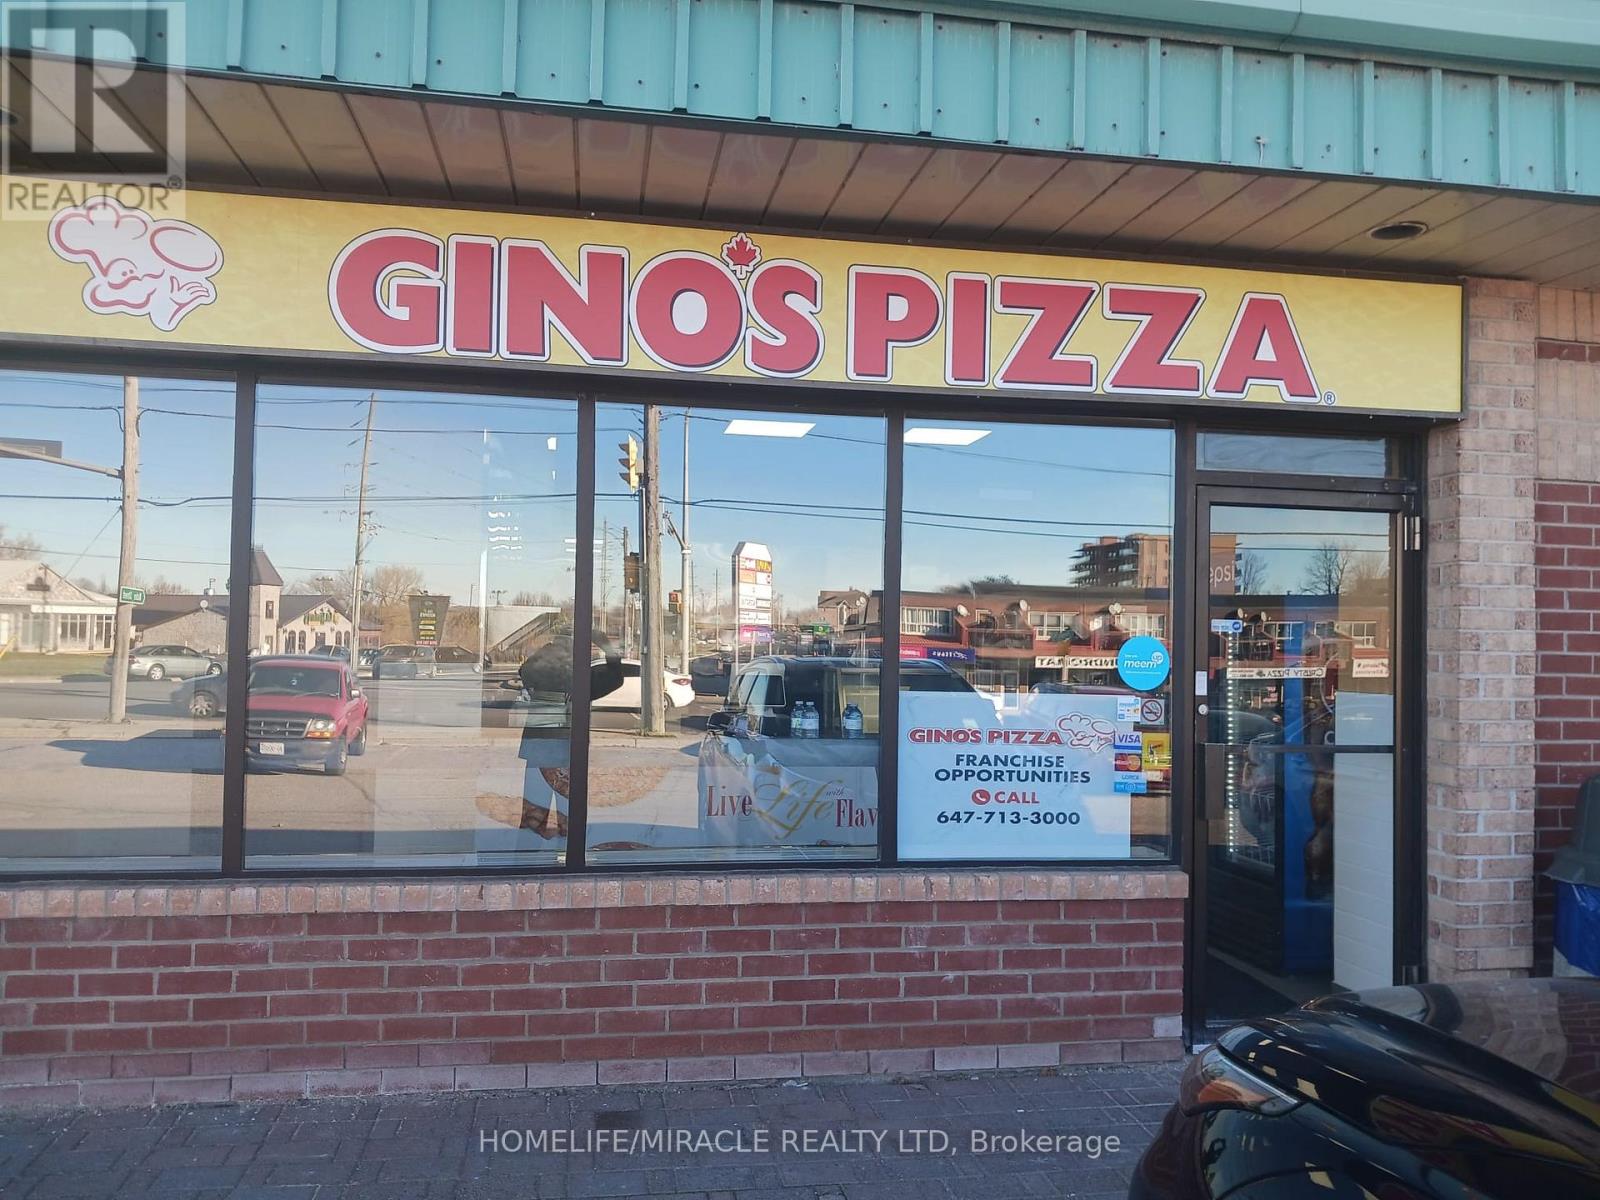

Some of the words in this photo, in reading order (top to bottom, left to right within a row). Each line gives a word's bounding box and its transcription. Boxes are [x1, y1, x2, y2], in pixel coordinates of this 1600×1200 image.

[846, 264, 1321, 404] PIZZA
[986, 729, 1065, 745] PIZZA
[1118, 734, 1141, 744] VISA
[955, 754, 1065, 768] FRANCHISE
[934, 768, 1091, 783] OPPORTUNITIES
[707, 785, 752, 816] Live
[826, 787, 845, 796] with
[994, 791, 1040, 804] CALL
[937, 811, 1080, 825] 647-713-3000
